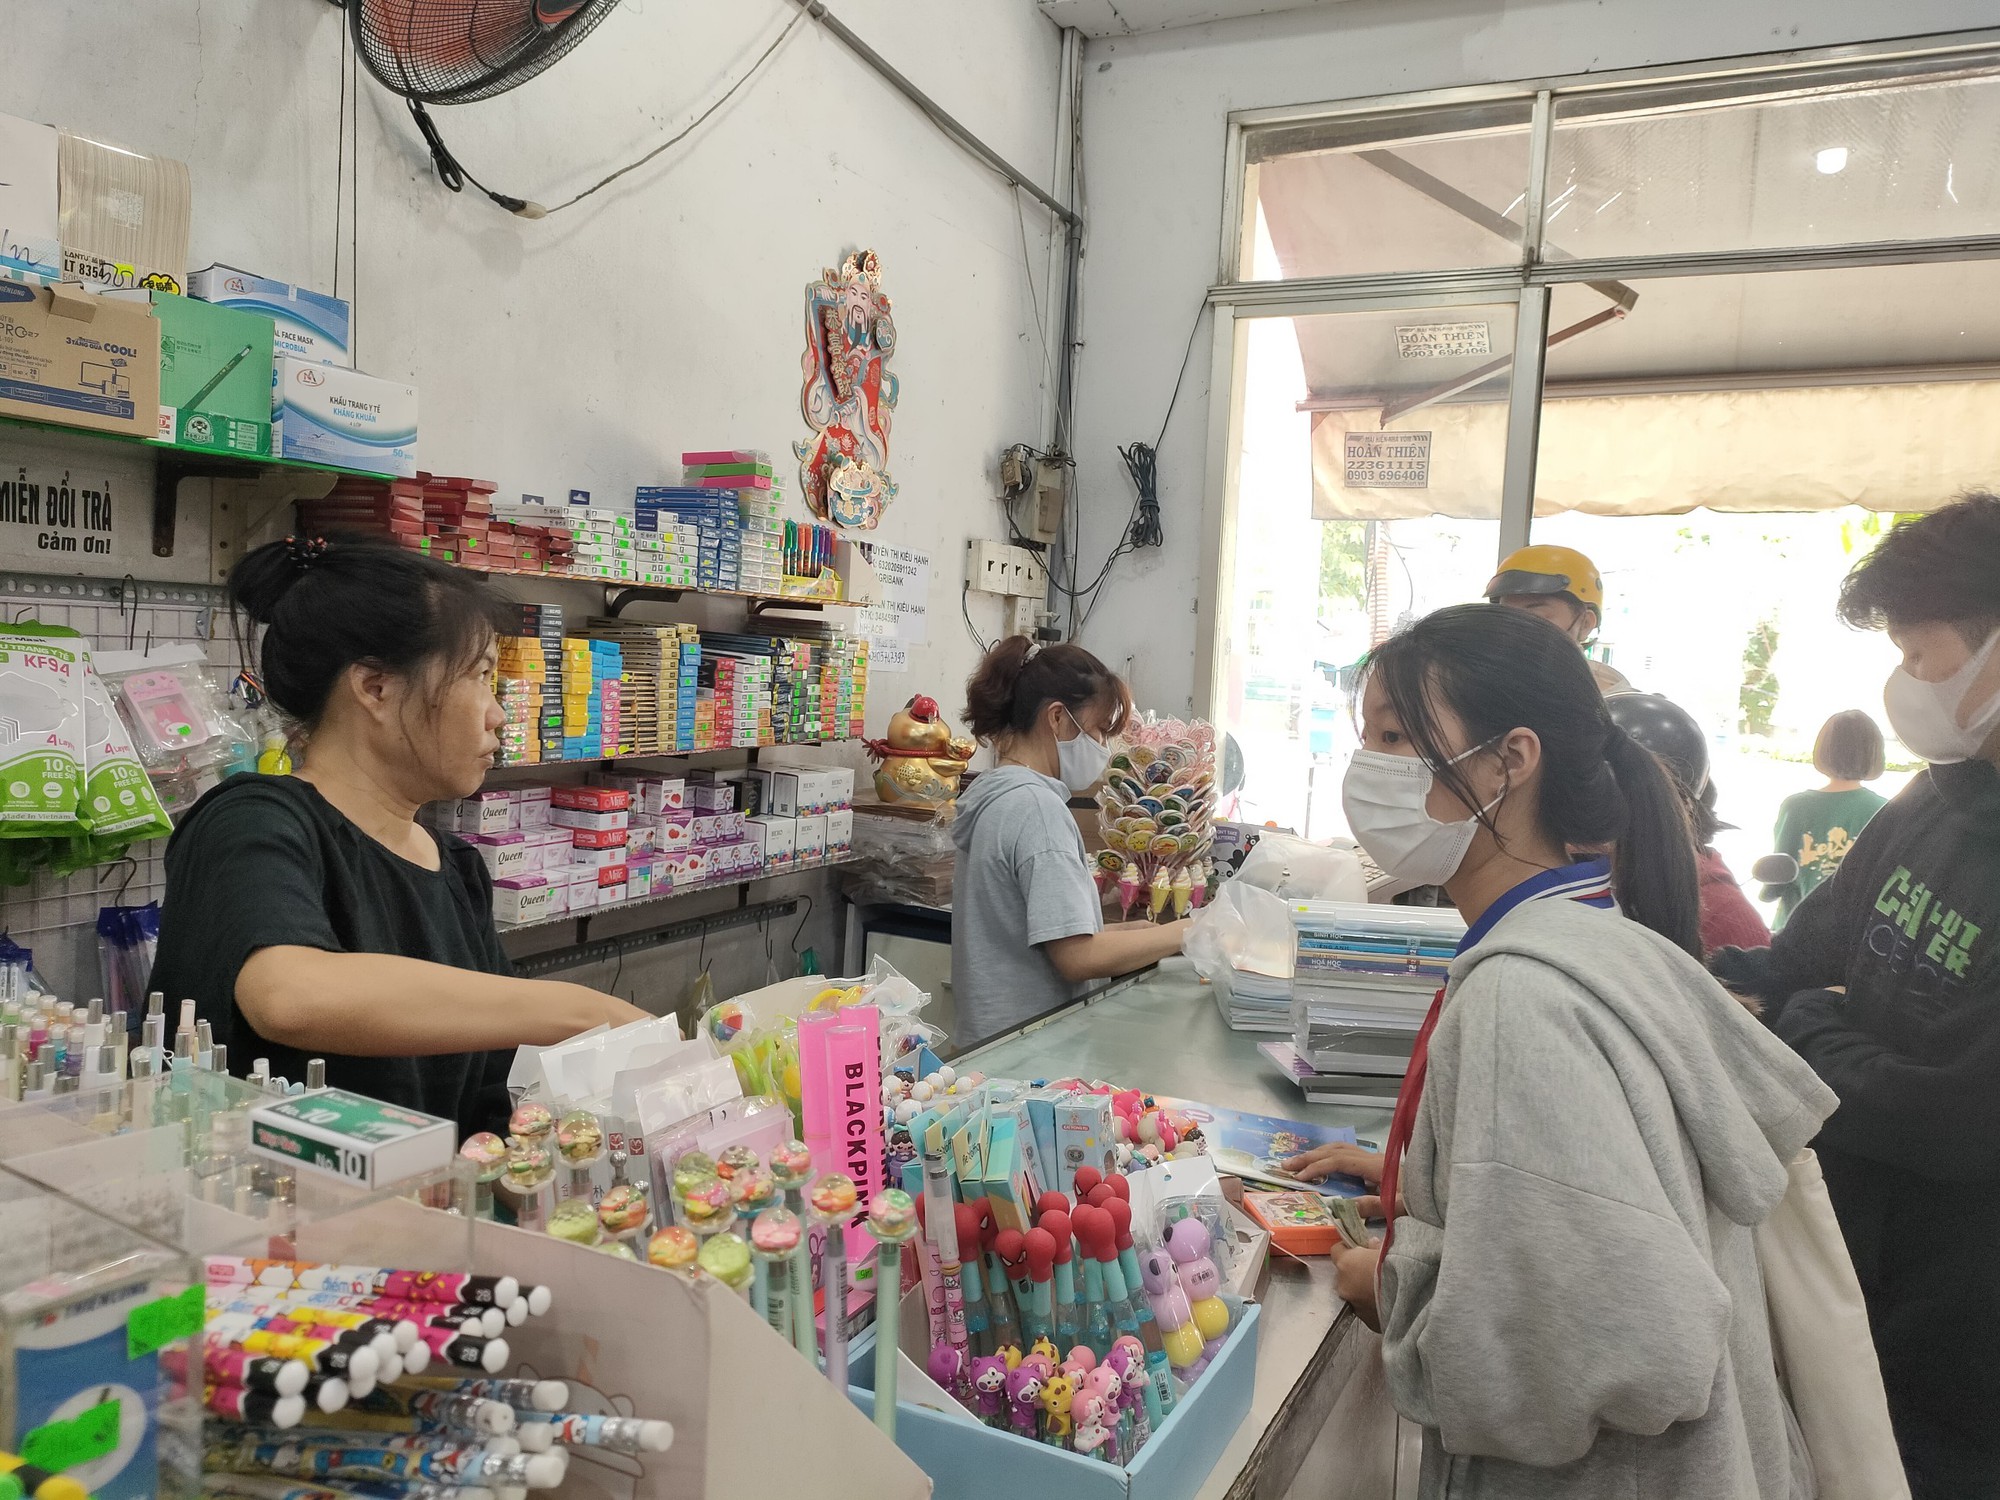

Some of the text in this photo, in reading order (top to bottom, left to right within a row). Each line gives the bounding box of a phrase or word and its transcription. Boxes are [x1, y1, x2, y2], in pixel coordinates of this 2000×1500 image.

[64, 259, 75, 273] LT
[79, 262, 104, 279] 8354
[282, 331, 297, 341] FACE
[297, 334, 314, 345] MASK
[104, 343, 137, 358] COOL!
[1402, 350, 1434, 358] 0903
[348, 400, 368, 411] TRANG
[369, 403, 375, 411] Y
[393, 449, 403, 458] 50
[1347, 443, 1382, 458] HOÀN
[1347, 460, 1426, 470] 22361115
[1347, 470, 1425, 481] 0903 696406
[46, 470, 76, 529] ĐỔI
[82, 480, 112, 532] TRẢ
[10, 644, 49, 655] TRANG
[24, 654, 70, 677] KF94
[46, 733, 57, 746] 4
[104, 743, 115, 755] 4
[43, 759, 64, 772] 10
[42, 771, 64, 779] FREE
[109, 766, 128, 781] 10
[114, 779, 131, 789] FREE
[482, 806, 508, 820] Queen
[498, 851, 523, 865] Queen
[520, 894, 545, 909] Queen
[300, 1108, 342, 1124] 10
[844, 1061, 870, 1229] BLACKPINK
[315, 1150, 363, 1179] No. 10
